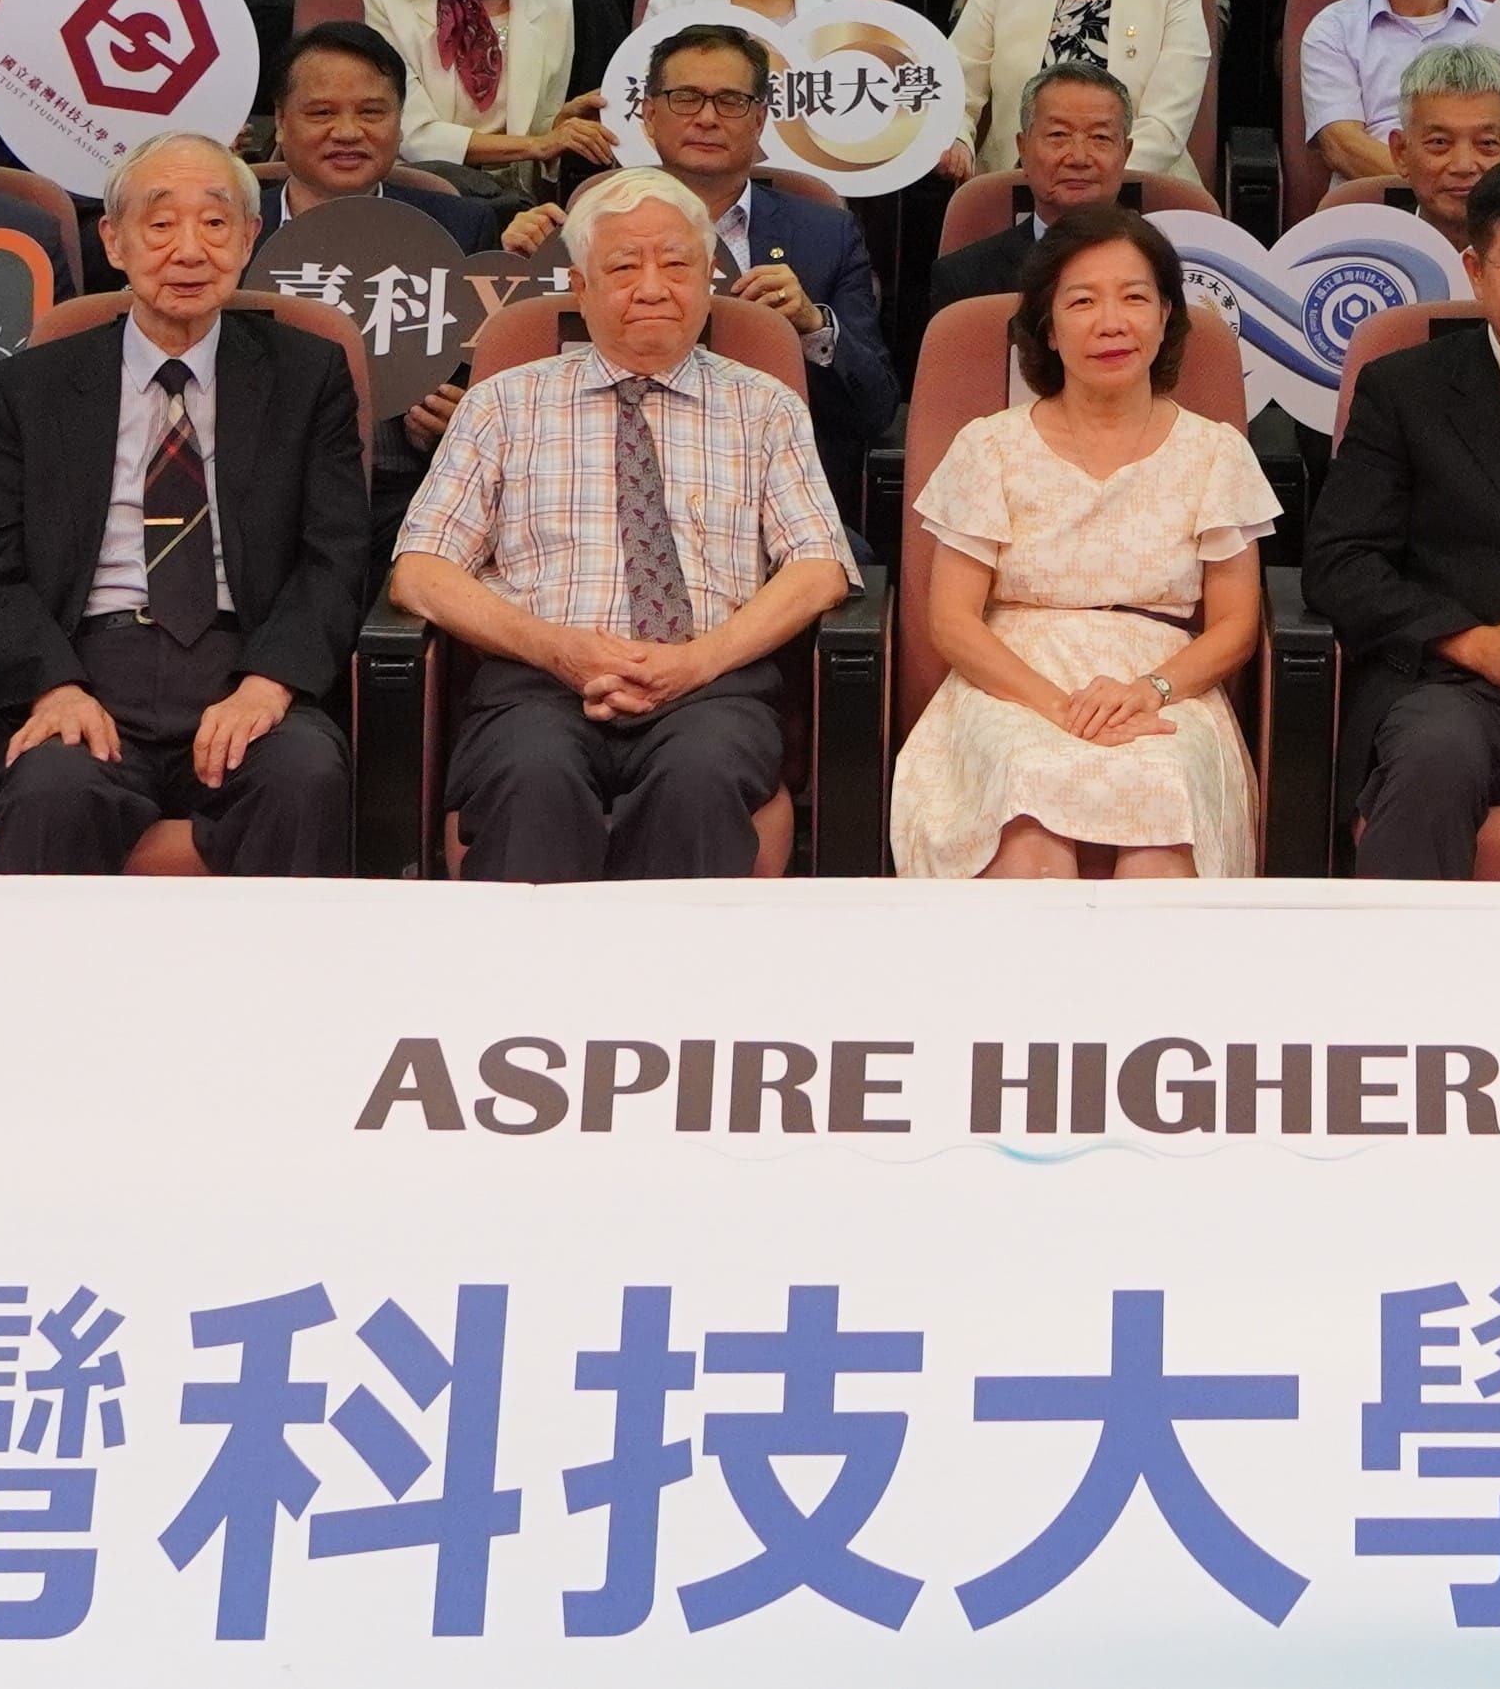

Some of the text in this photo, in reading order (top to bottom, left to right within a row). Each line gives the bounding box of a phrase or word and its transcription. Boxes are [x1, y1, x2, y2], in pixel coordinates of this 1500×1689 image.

[0, 54, 109, 143] 國立臺灣科技大學
[27, 99, 73, 136] STUDENT
[73, 136, 116, 169] ASSOCI
[355, 1037, 913, 1135] ASPIRE
[971, 1037, 1500, 1135] HIGHER
